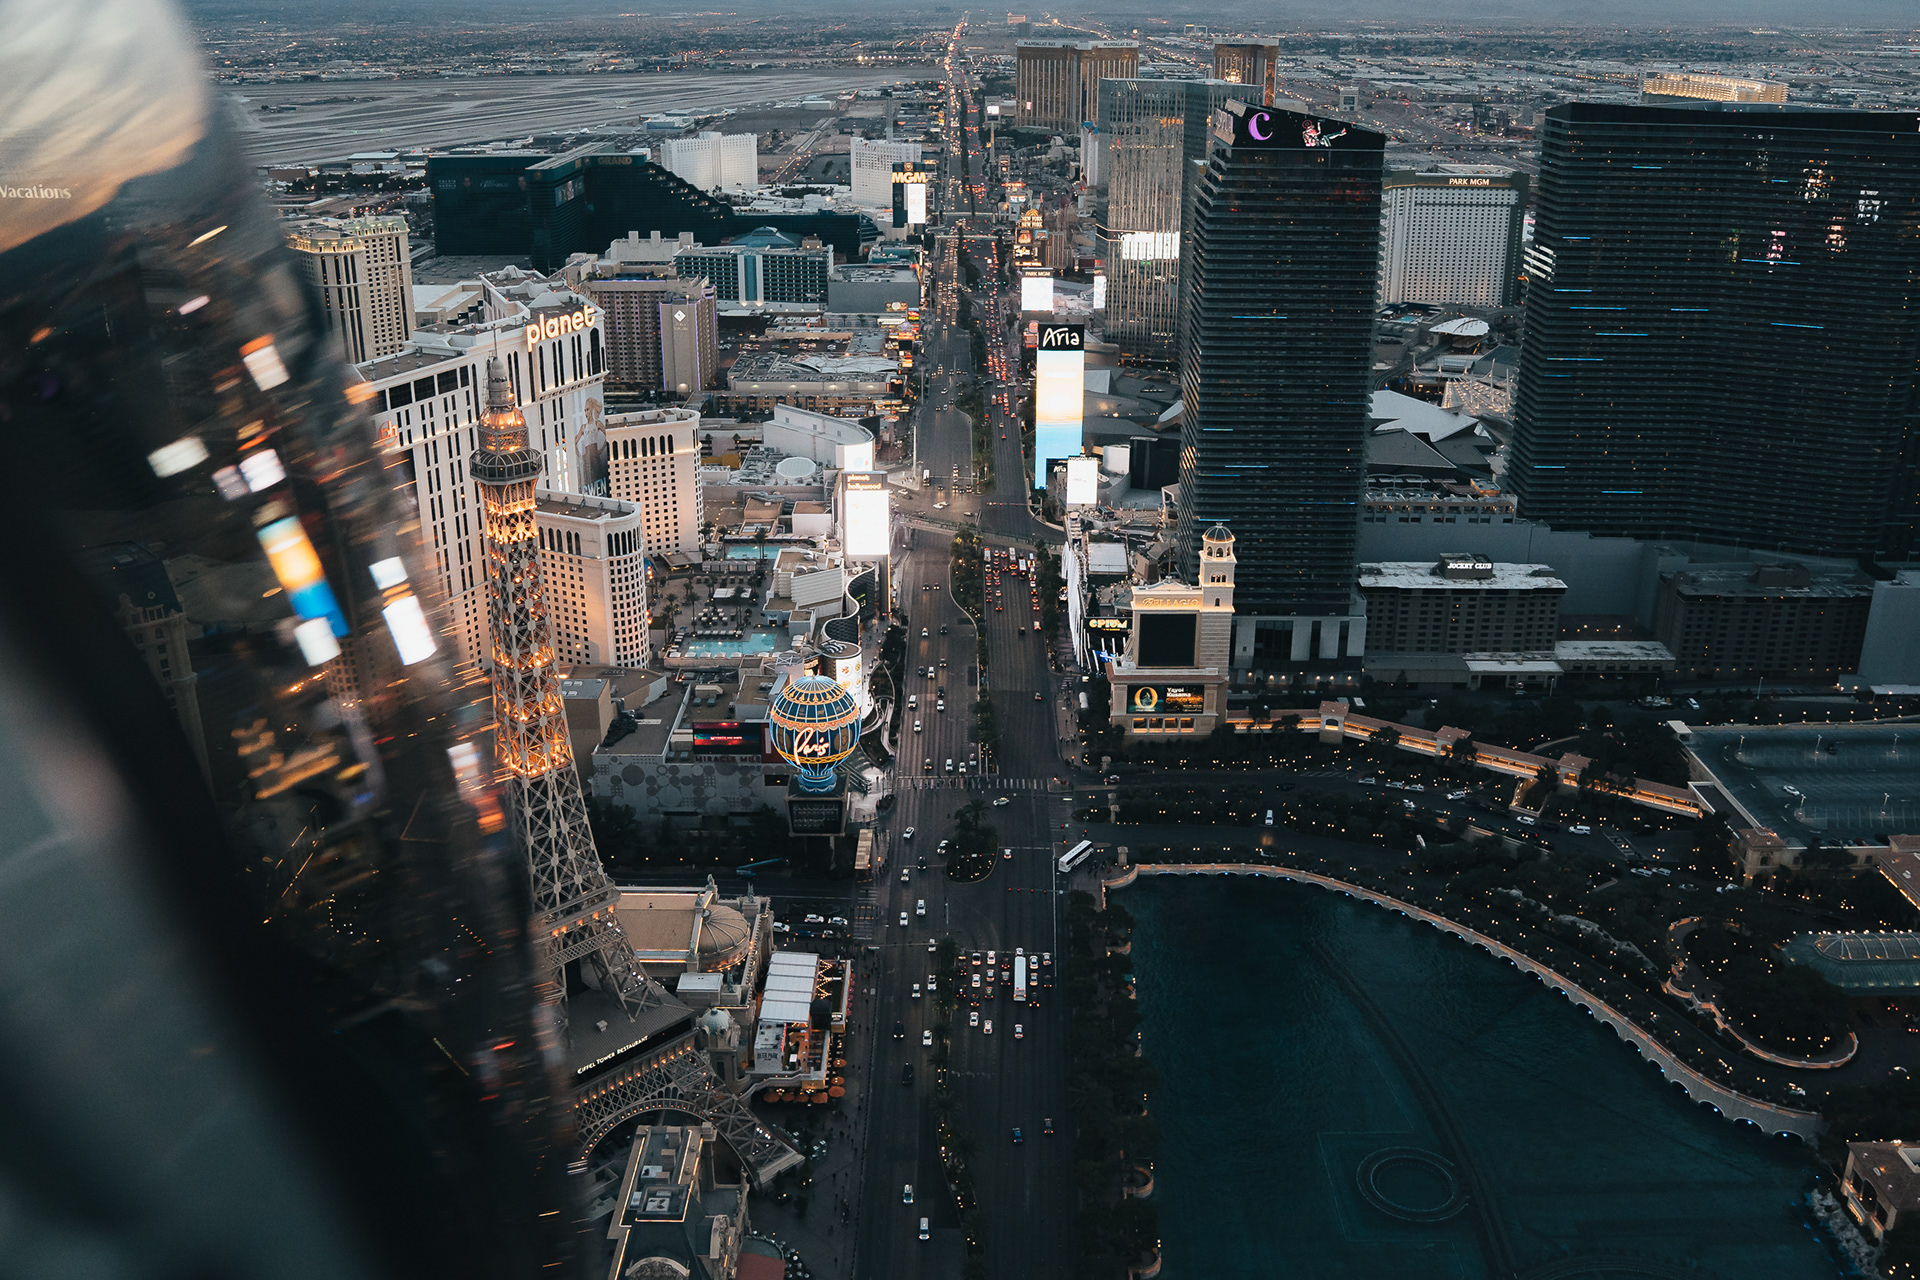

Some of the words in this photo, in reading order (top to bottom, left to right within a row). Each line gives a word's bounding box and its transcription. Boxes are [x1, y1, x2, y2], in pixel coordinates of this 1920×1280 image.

[597, 156, 633, 165] GRAND
[891, 172, 927, 184] MGM
[0, 184, 71, 199] Vacations
[526, 304, 596, 353] planet
[1042, 327, 1080, 347] Aria
[847, 473, 871, 482] planet
[847, 482, 882, 491] hollywood
[1475, 562, 1493, 570] CLUB
[1143, 598, 1199, 607] BELLAGIO
[793, 727, 830, 765] Paris
[577, 1062, 596, 1074] EIFFEL
[596, 1052, 615, 1064] TOWER
[616, 1035, 649, 1055] RESTAURANT
